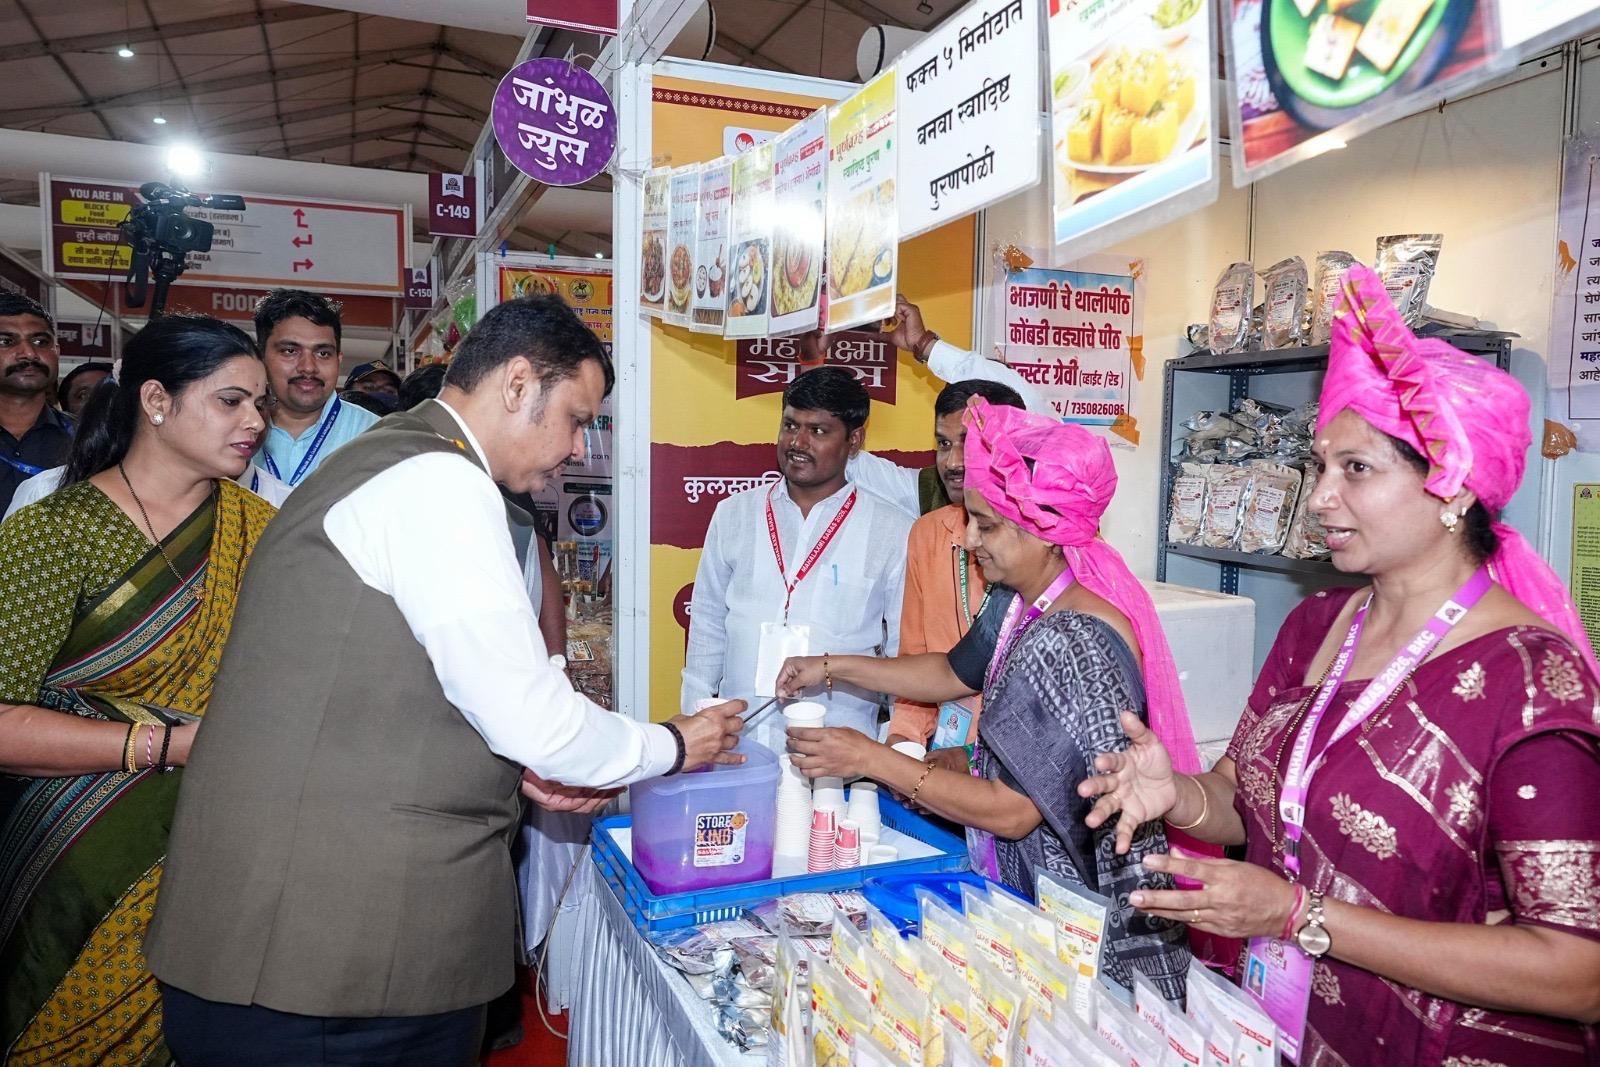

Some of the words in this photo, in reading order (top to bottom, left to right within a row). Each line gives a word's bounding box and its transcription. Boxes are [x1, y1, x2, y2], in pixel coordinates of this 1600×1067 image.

[907, 55, 938, 93] फक्त
[943, 47, 953, 70] ५
[512, 77, 608, 134] जांभुळ
[517, 122, 589, 171] ज्युस
[930, 144, 995, 211] पुरणपोळी
[69, 188, 89, 198] YOU
[92, 190, 111, 200] ARE
[113, 192, 123, 201] IN
[436, 203, 470, 219] C-149
[409, 288, 432, 297] C-150
[1010, 282, 1058, 310] भाजणी
[1060, 283, 1072, 311] चे
[1075, 287, 1131, 315] थालीपीठ
[1009, 317, 1050, 346] कोंबडी
[1052, 322, 1096, 349] वड्यांचे
[1098, 323, 1121, 349] पीठ
[1053, 358, 1079, 386] ग्रेवी
[801, 541, 825, 573] MAHALAXMI
[822, 522, 838, 541] SARAS
[1007, 597, 1021, 615] BKC
[1349, 682, 1387, 722] SARAS
[1406, 629, 1436, 660] BKC
[1286, 714, 1317, 787] MAHALAXMI
[1312, 676, 1337, 714] SARAS
[1345, 623, 1359, 648] BKC
[698, 815, 732, 829] STORE
